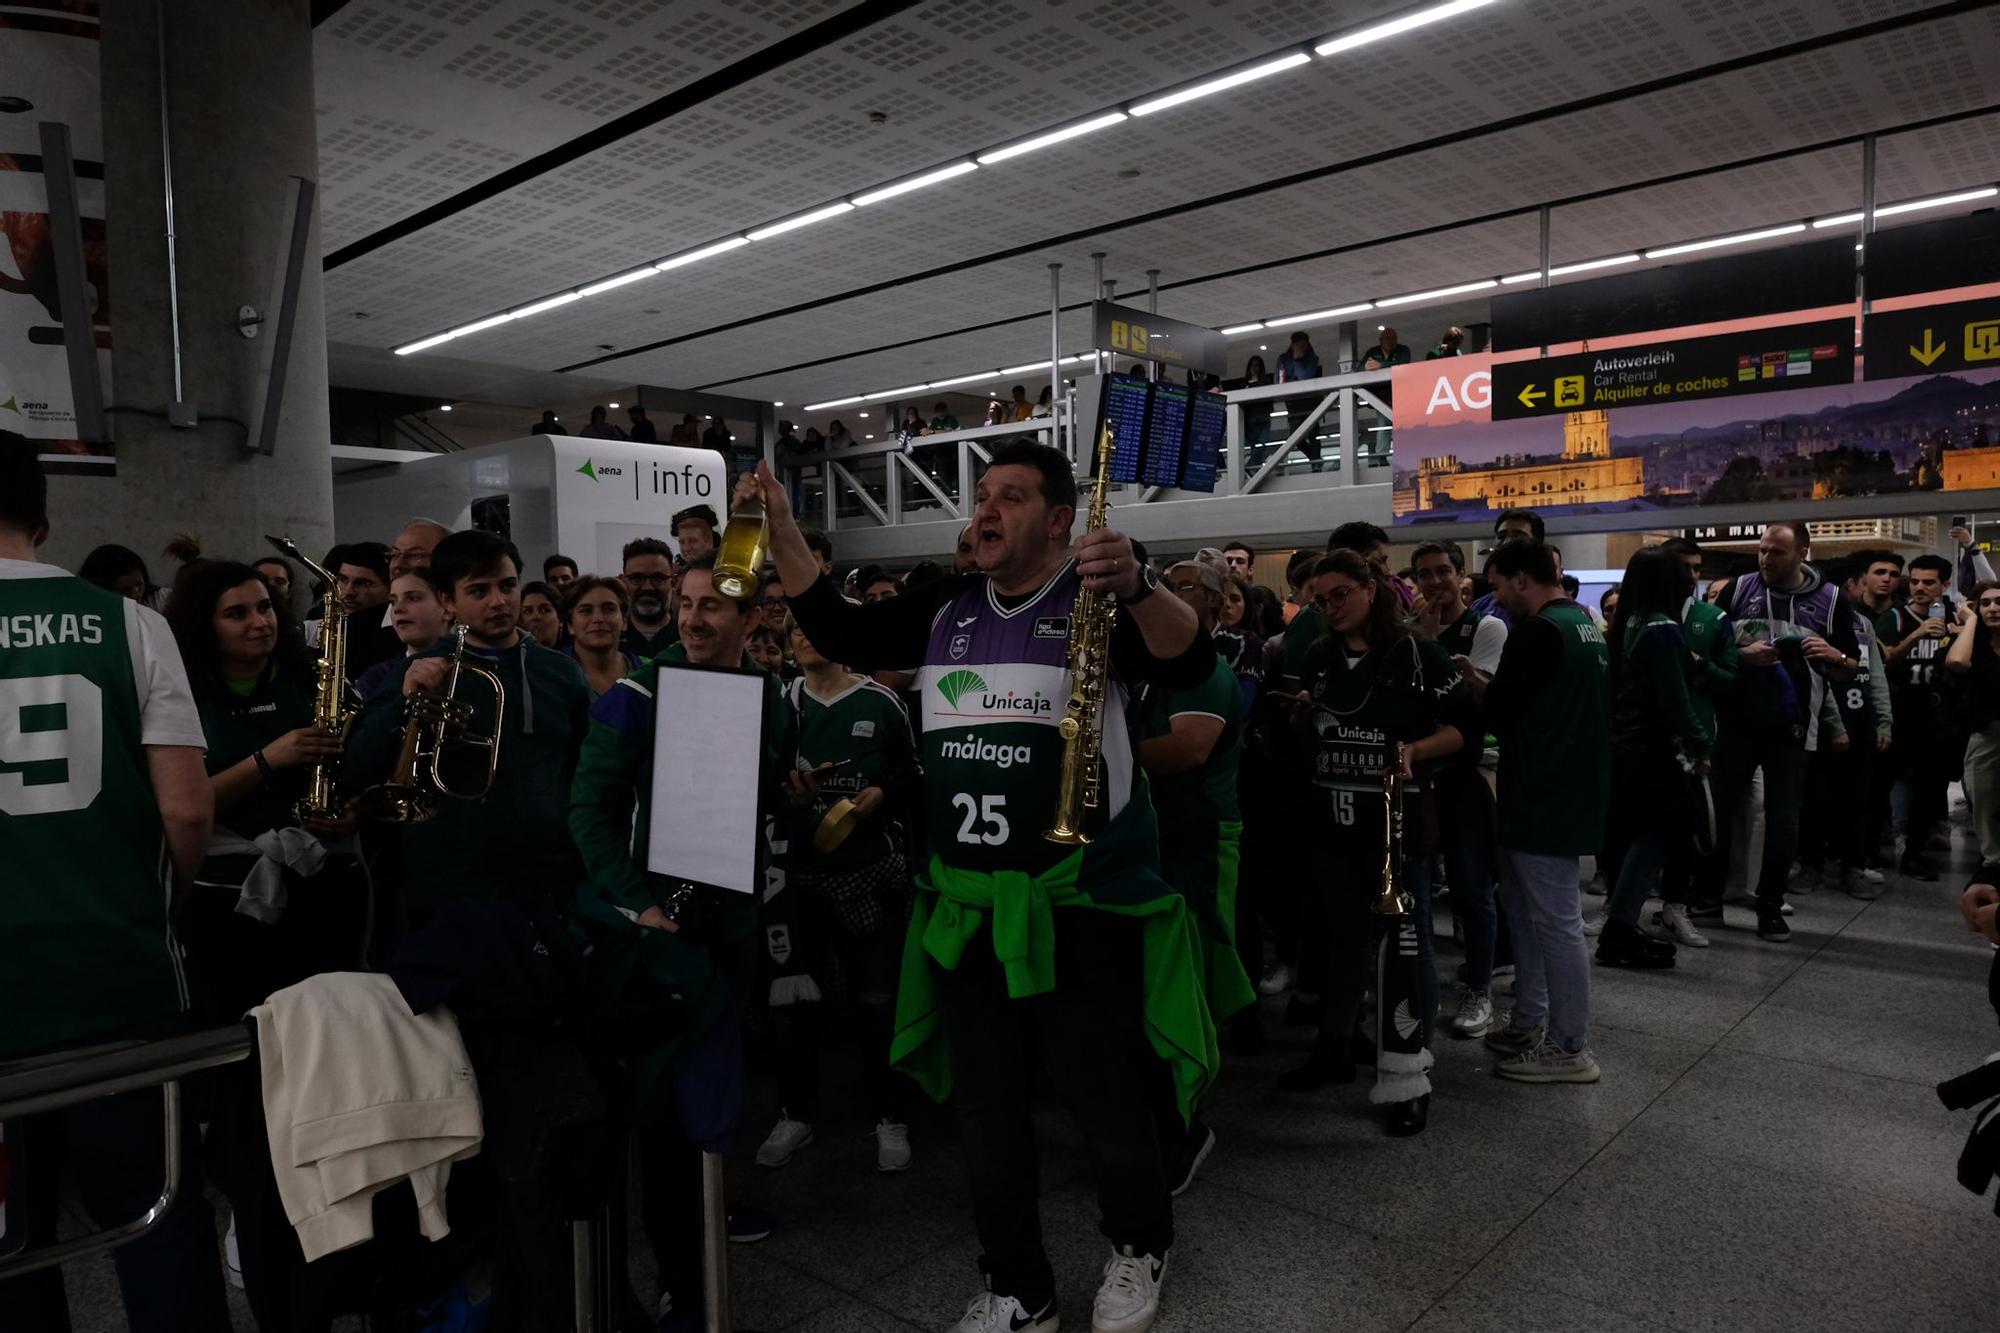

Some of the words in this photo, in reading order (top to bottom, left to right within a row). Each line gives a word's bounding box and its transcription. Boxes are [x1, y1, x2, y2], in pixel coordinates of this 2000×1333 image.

[1593, 350, 1675, 373] Autoverleih
[1593, 374, 1615, 387] Car
[1618, 369, 1657, 384] Rental
[1593, 384, 1648, 403] Alquiler
[1653, 381, 1671, 396] de
[1676, 376, 1729, 392] coches
[1425, 371, 1492, 415] AG
[22, 402, 48, 410] aena
[598, 466, 622, 476] aena
[653, 462, 711, 497] info
[1695, 526, 1717, 538] LA
[982, 691, 1052, 714] Unicaja
[1846, 687, 1865, 710] 8
[0, 673, 103, 817] 9
[1337, 725, 1386, 743] Unicaja
[940, 733, 1032, 768] málaga
[951, 792, 1011, 847] 25
[1330, 790, 1355, 826] 15
